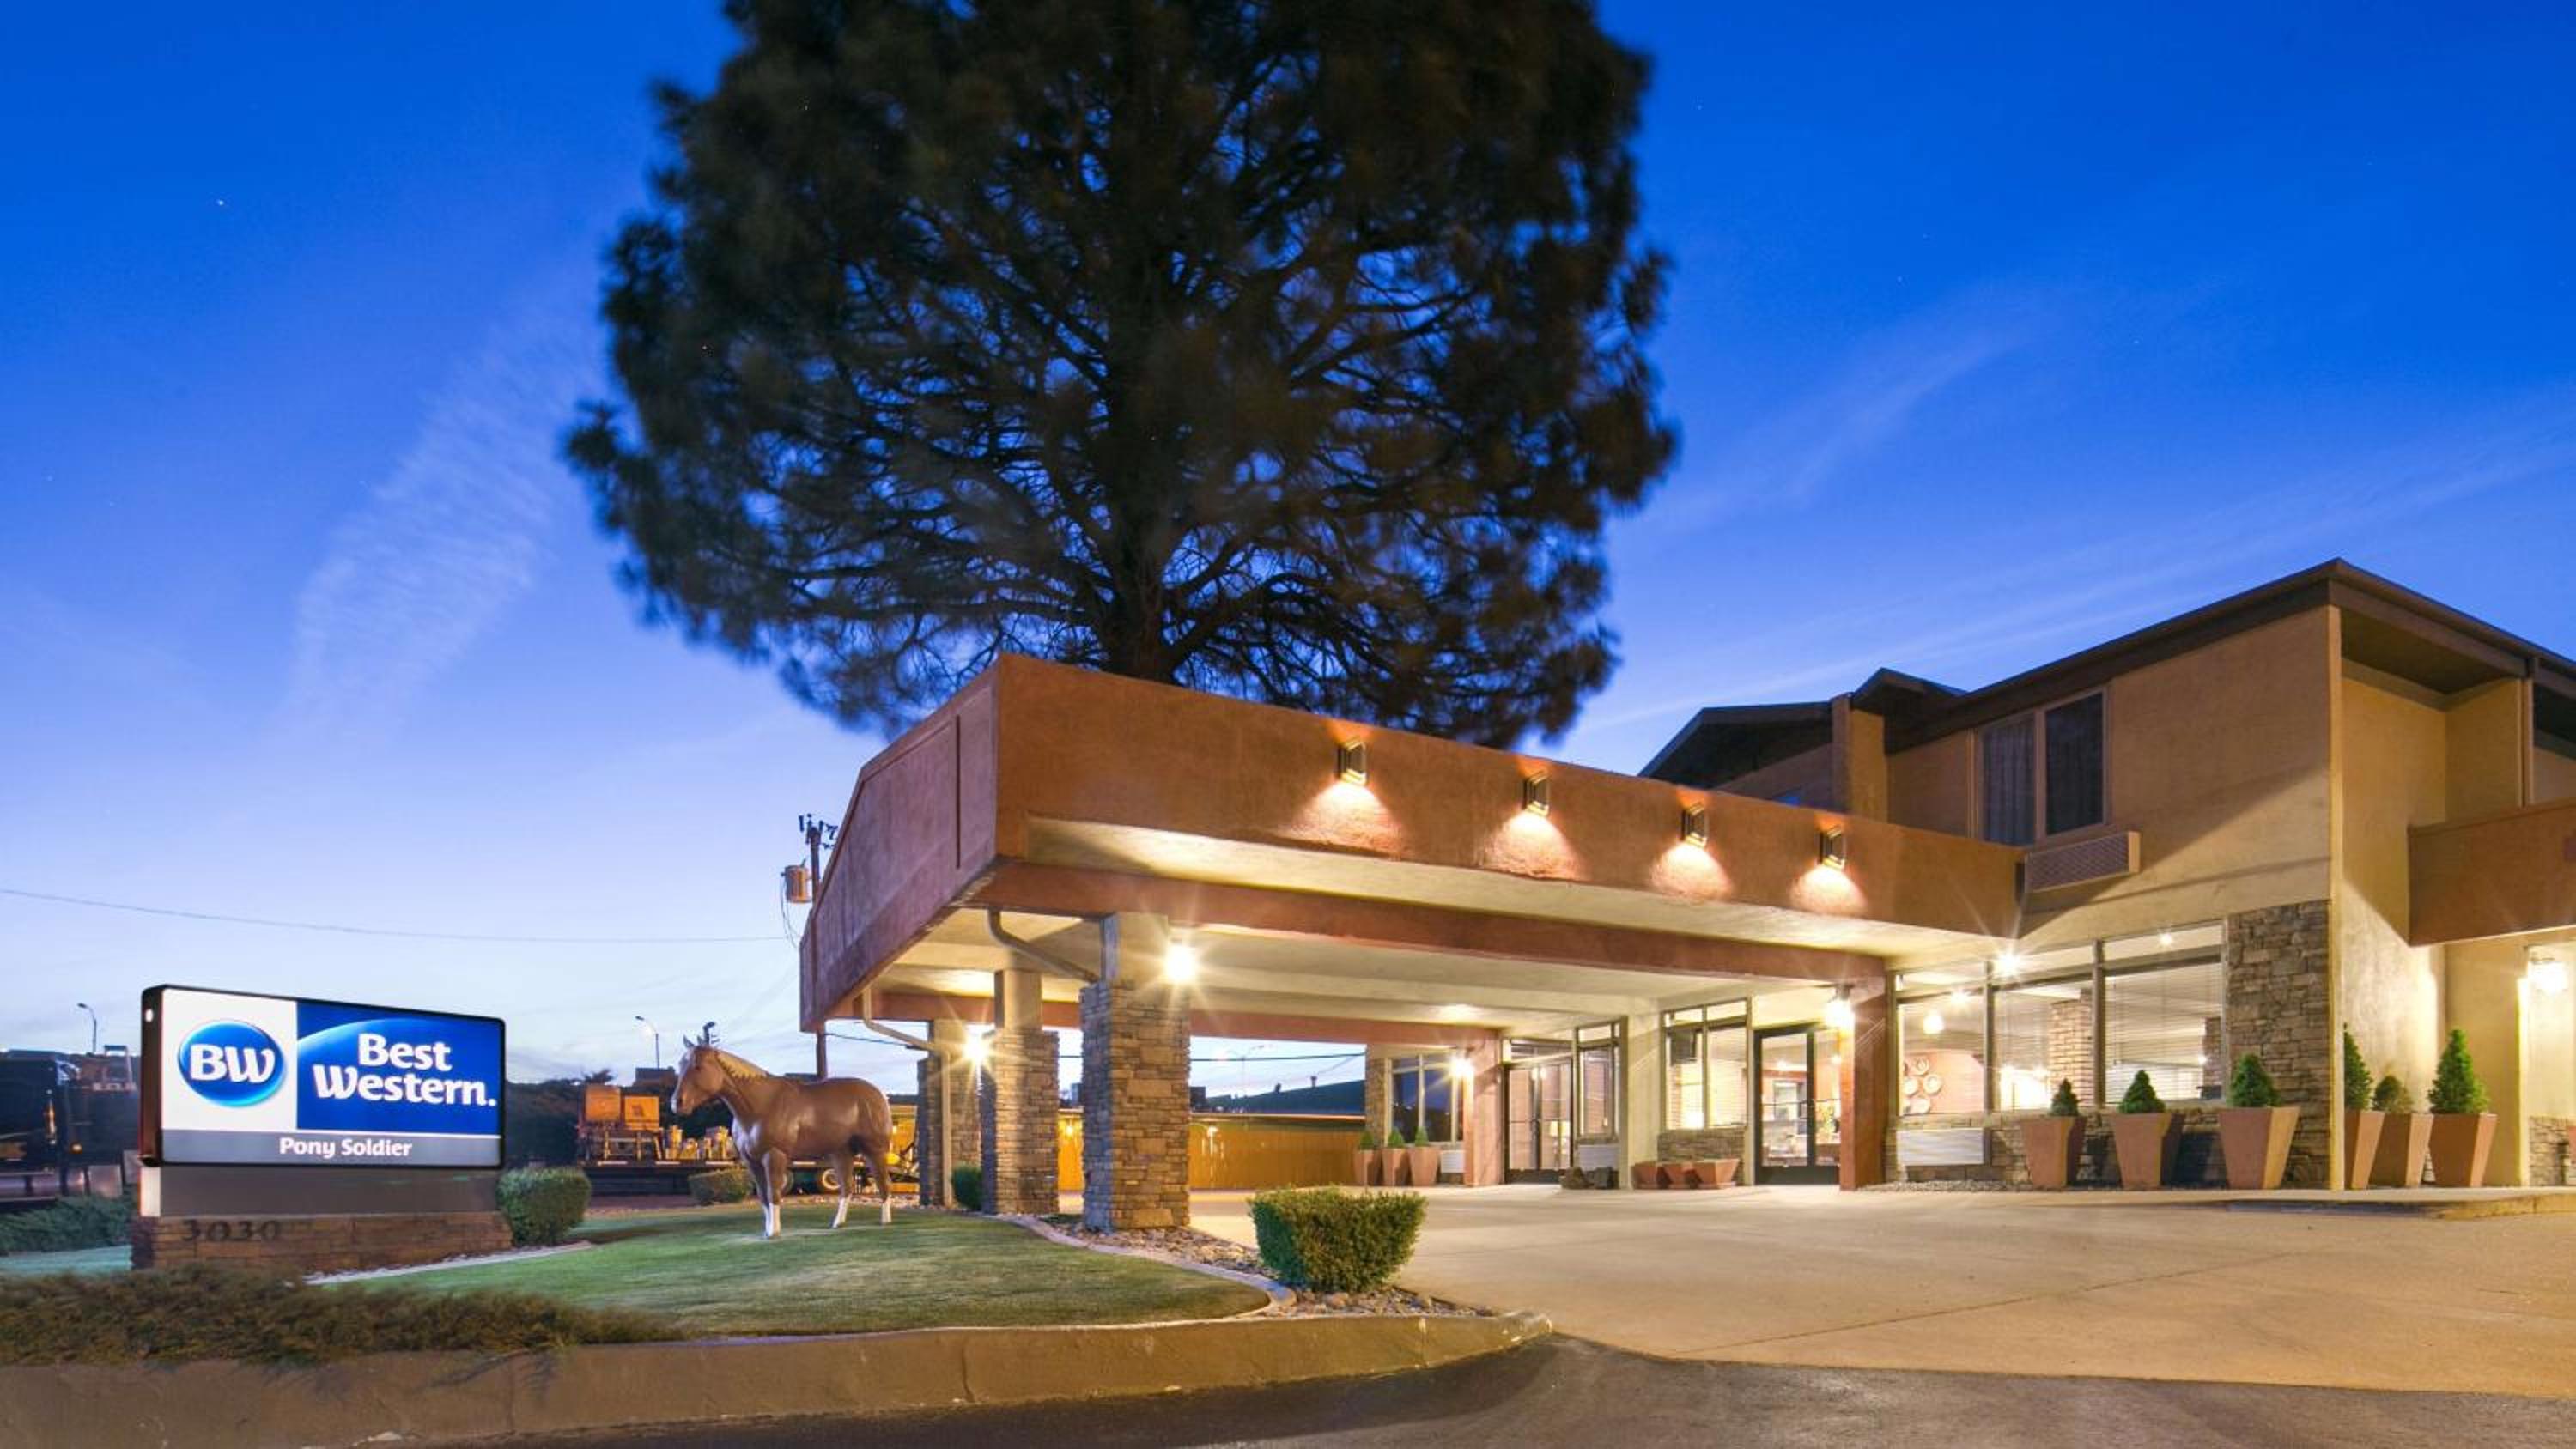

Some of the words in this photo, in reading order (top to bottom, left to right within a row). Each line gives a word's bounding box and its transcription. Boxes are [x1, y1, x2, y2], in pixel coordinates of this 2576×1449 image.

[189, 1043, 276, 1083] BW
[357, 1033, 452, 1072] Best
[279, 1137, 336, 1158] Pony
[340, 1138, 413, 1157] Soldier
[181, 1218, 281, 1242] 3030
